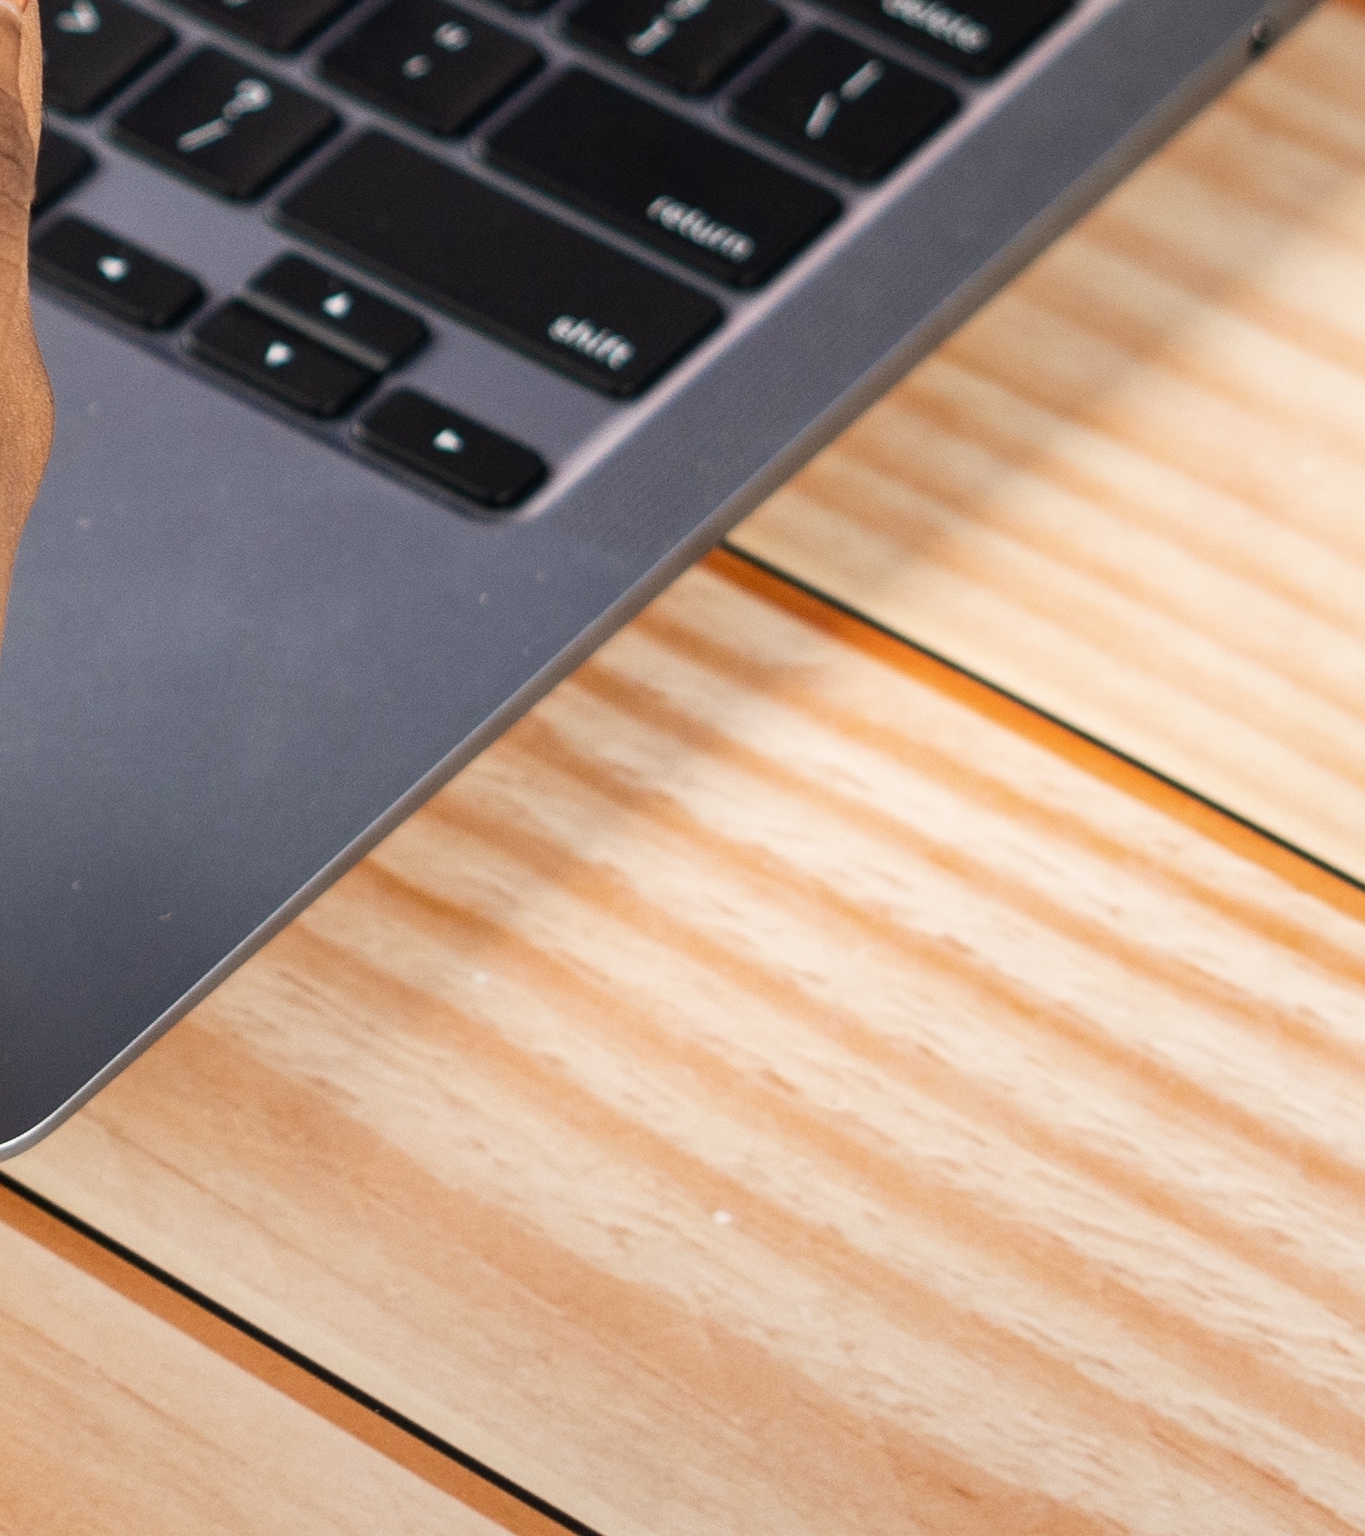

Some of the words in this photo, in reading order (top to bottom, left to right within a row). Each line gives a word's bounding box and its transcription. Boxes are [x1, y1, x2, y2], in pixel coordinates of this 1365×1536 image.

[222, 77, 272, 119] ?
[646, 194, 756, 263] return
[547, 314, 637, 372] shift
